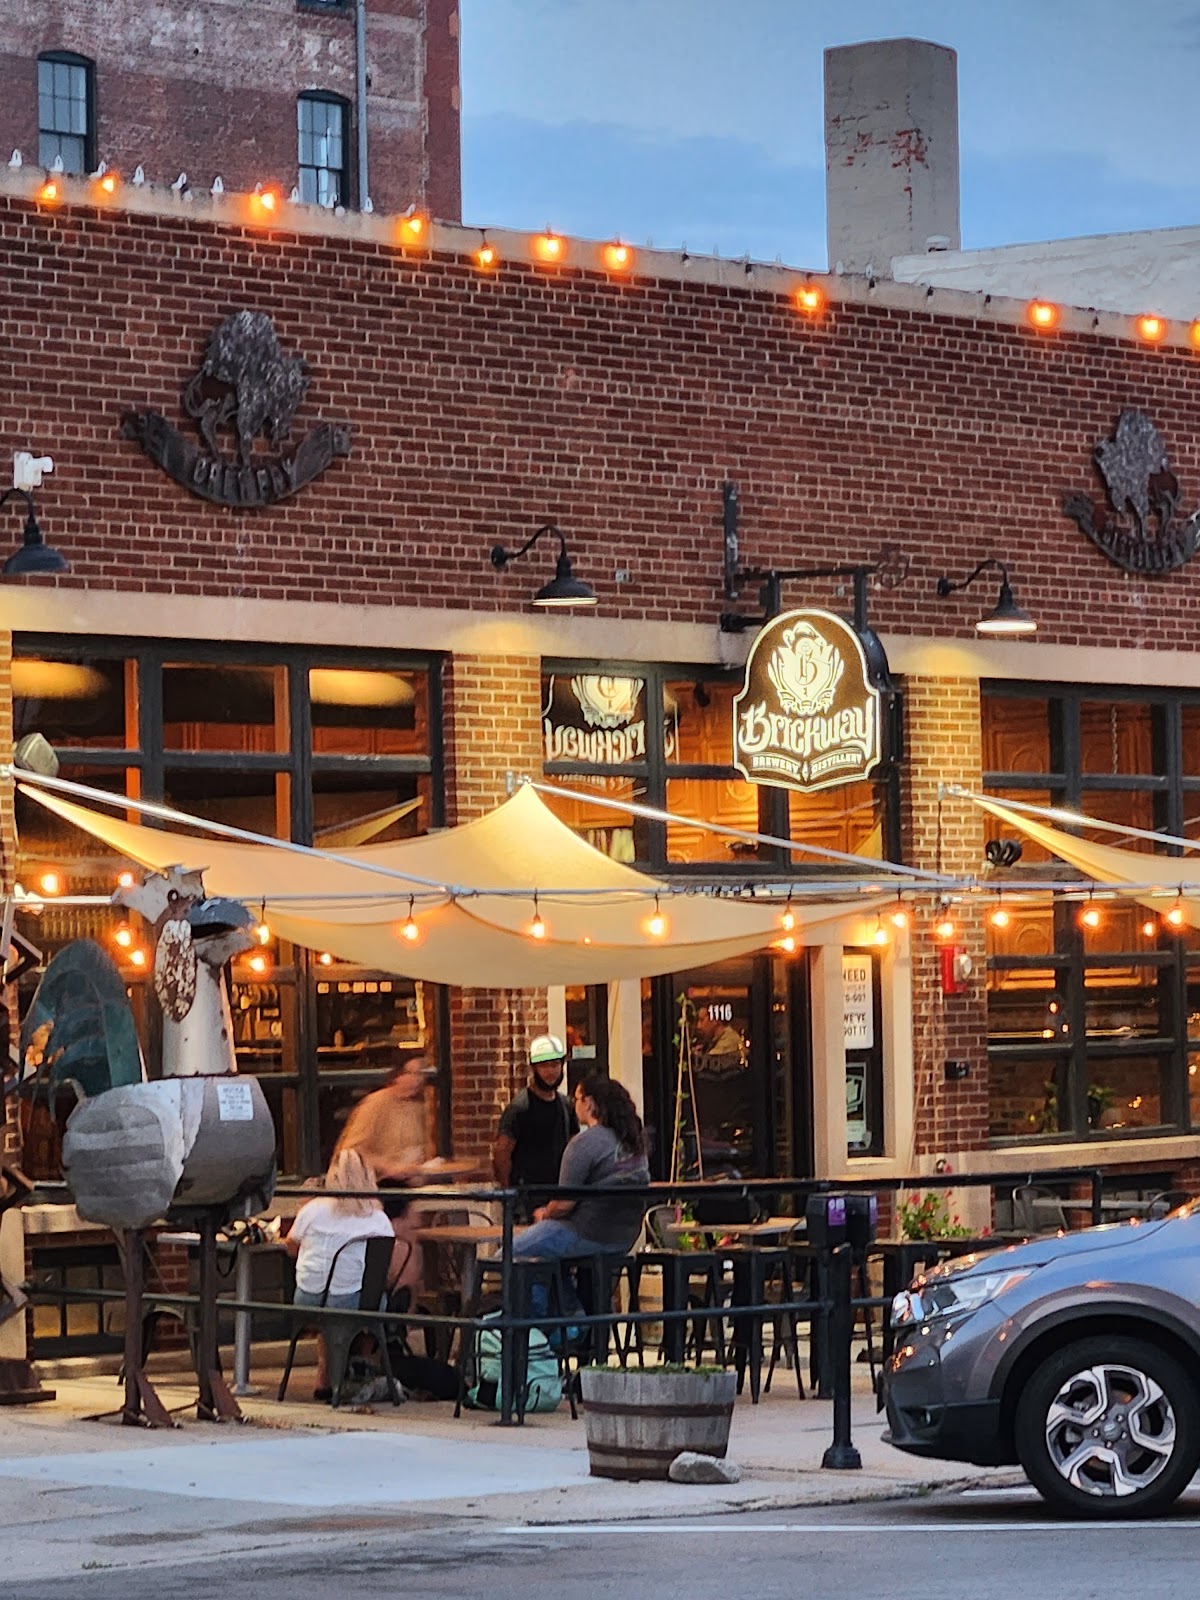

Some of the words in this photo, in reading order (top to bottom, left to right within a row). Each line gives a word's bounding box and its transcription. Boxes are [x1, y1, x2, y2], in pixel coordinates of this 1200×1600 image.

[738, 695, 874, 760] Brickway
[752, 756, 799, 775] BREWERY
[811, 753, 862, 774] DISTILLERY
[708, 1003, 733, 1021] 1116
